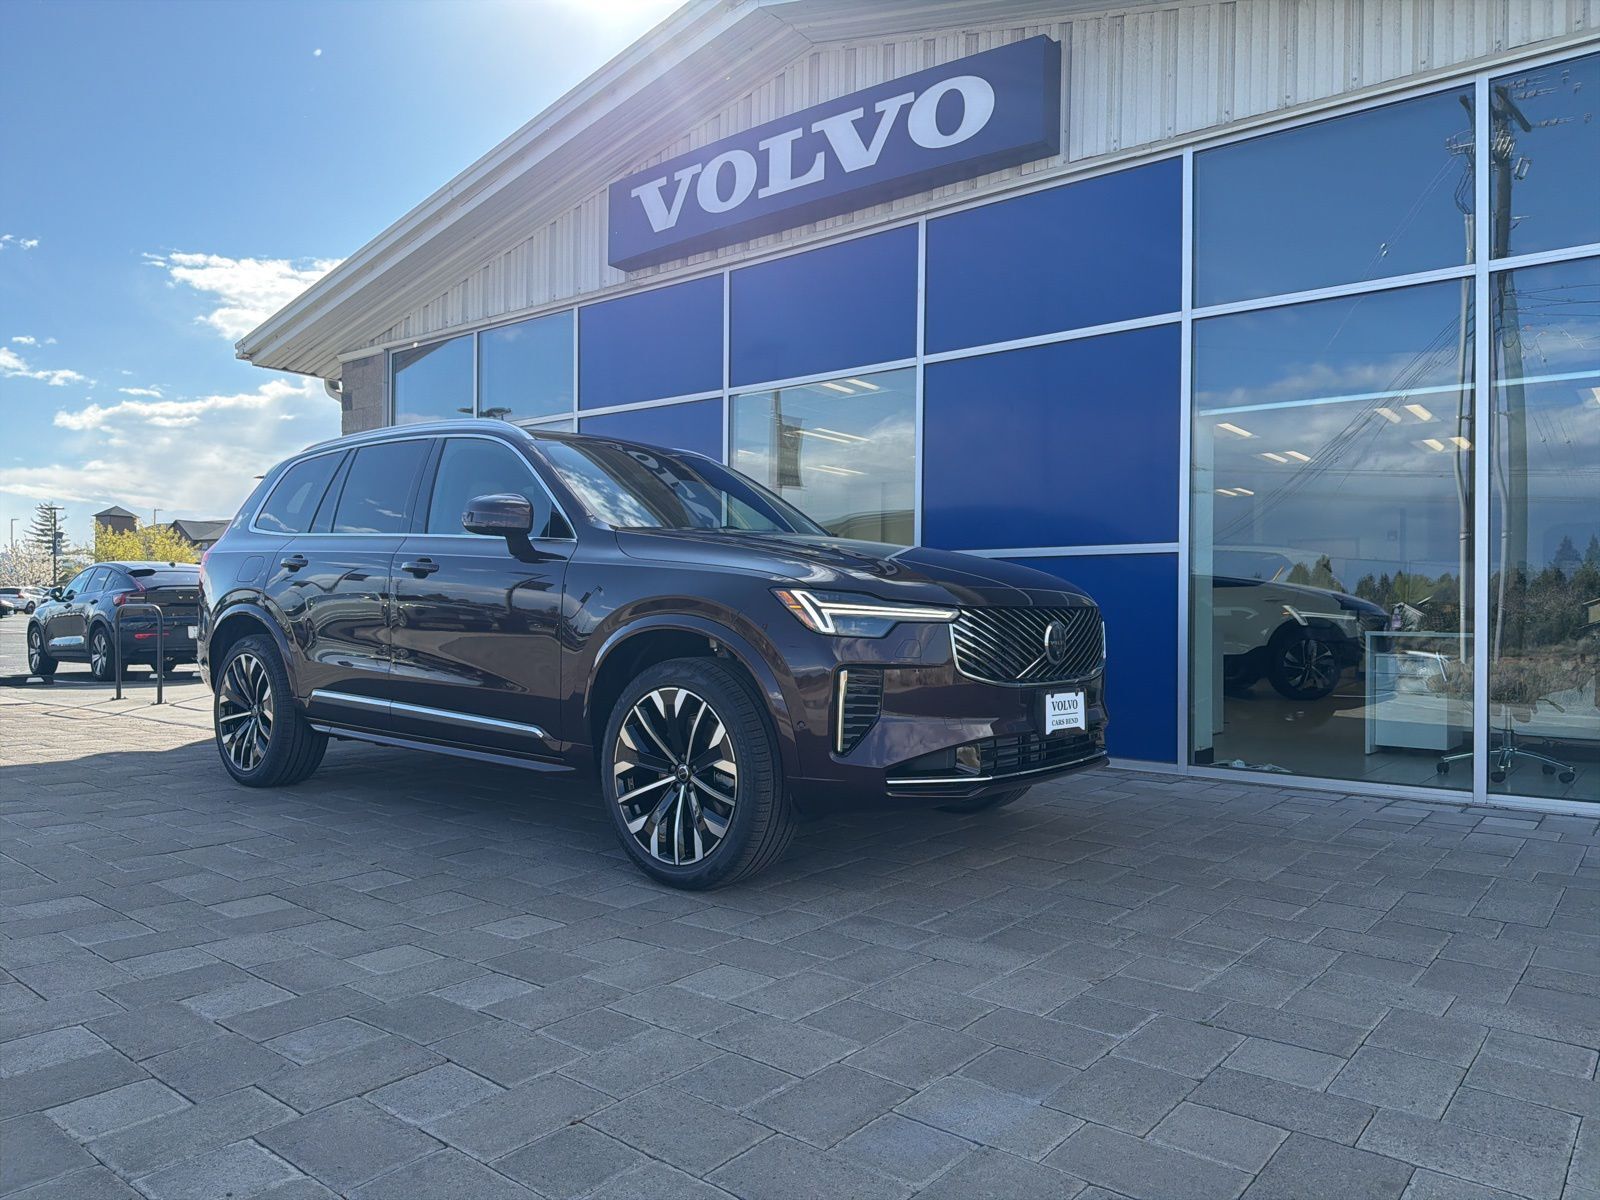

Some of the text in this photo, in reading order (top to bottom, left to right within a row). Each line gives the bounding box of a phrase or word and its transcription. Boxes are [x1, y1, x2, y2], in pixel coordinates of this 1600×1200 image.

[631, 75, 995, 233] VOLVO
[1051, 699, 1079, 711] VOLVO
[1065, 717, 1079, 725] BEND
